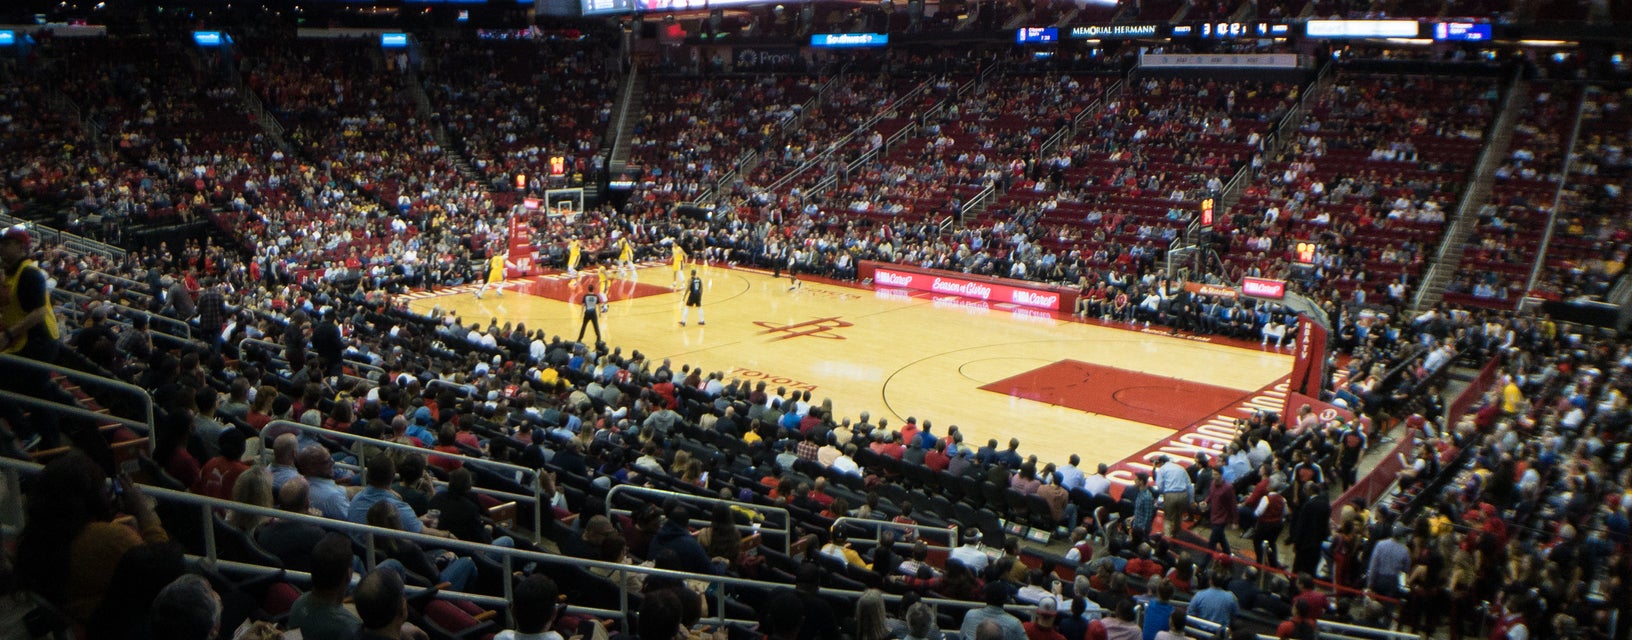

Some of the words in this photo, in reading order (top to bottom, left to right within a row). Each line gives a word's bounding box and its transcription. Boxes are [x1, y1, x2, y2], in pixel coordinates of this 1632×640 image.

[1072, 25, 1112, 35] MEMORIAL
[1114, 25, 1156, 34] HERMANN
[1203, 23, 1211, 35] 3
[1258, 23, 1267, 34] 4
[826, 34, 867, 44] Southwest
[932, 277, 960, 292] Season
[966, 282, 991, 299] Giving
[1029, 292, 1056, 308] Cares
[732, 367, 819, 392] TOYOTA
